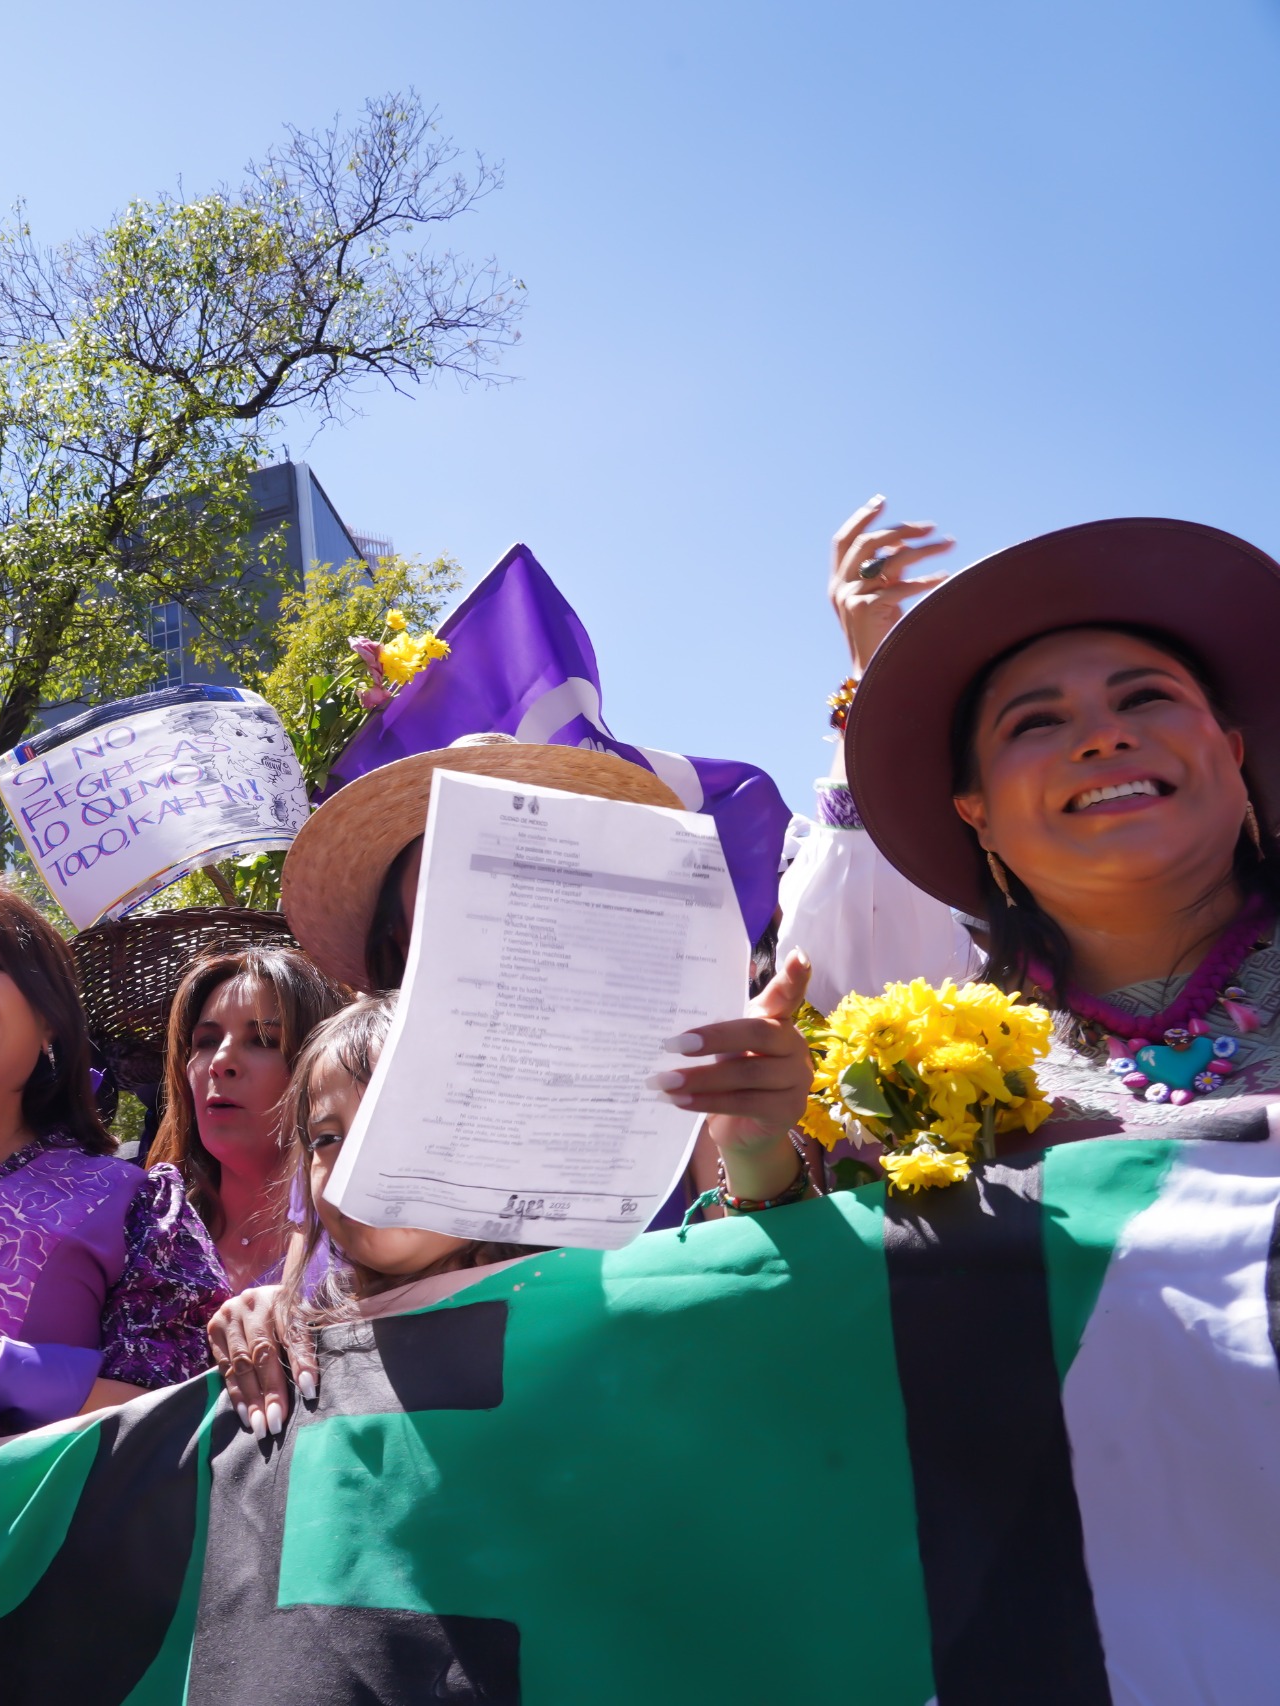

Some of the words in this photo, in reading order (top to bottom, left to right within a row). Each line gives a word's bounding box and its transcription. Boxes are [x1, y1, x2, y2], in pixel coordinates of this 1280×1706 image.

[12, 761, 54, 800] SI
[71, 725, 136, 770] NO
[20, 734, 231, 833] REGRESAS
[31, 820, 71, 858] LO
[81, 763, 205, 827] QUEMO
[46, 828, 131, 887] TODO,
[127, 778, 266, 836] KAREN!
[548, 1202, 570, 1210] 2025
